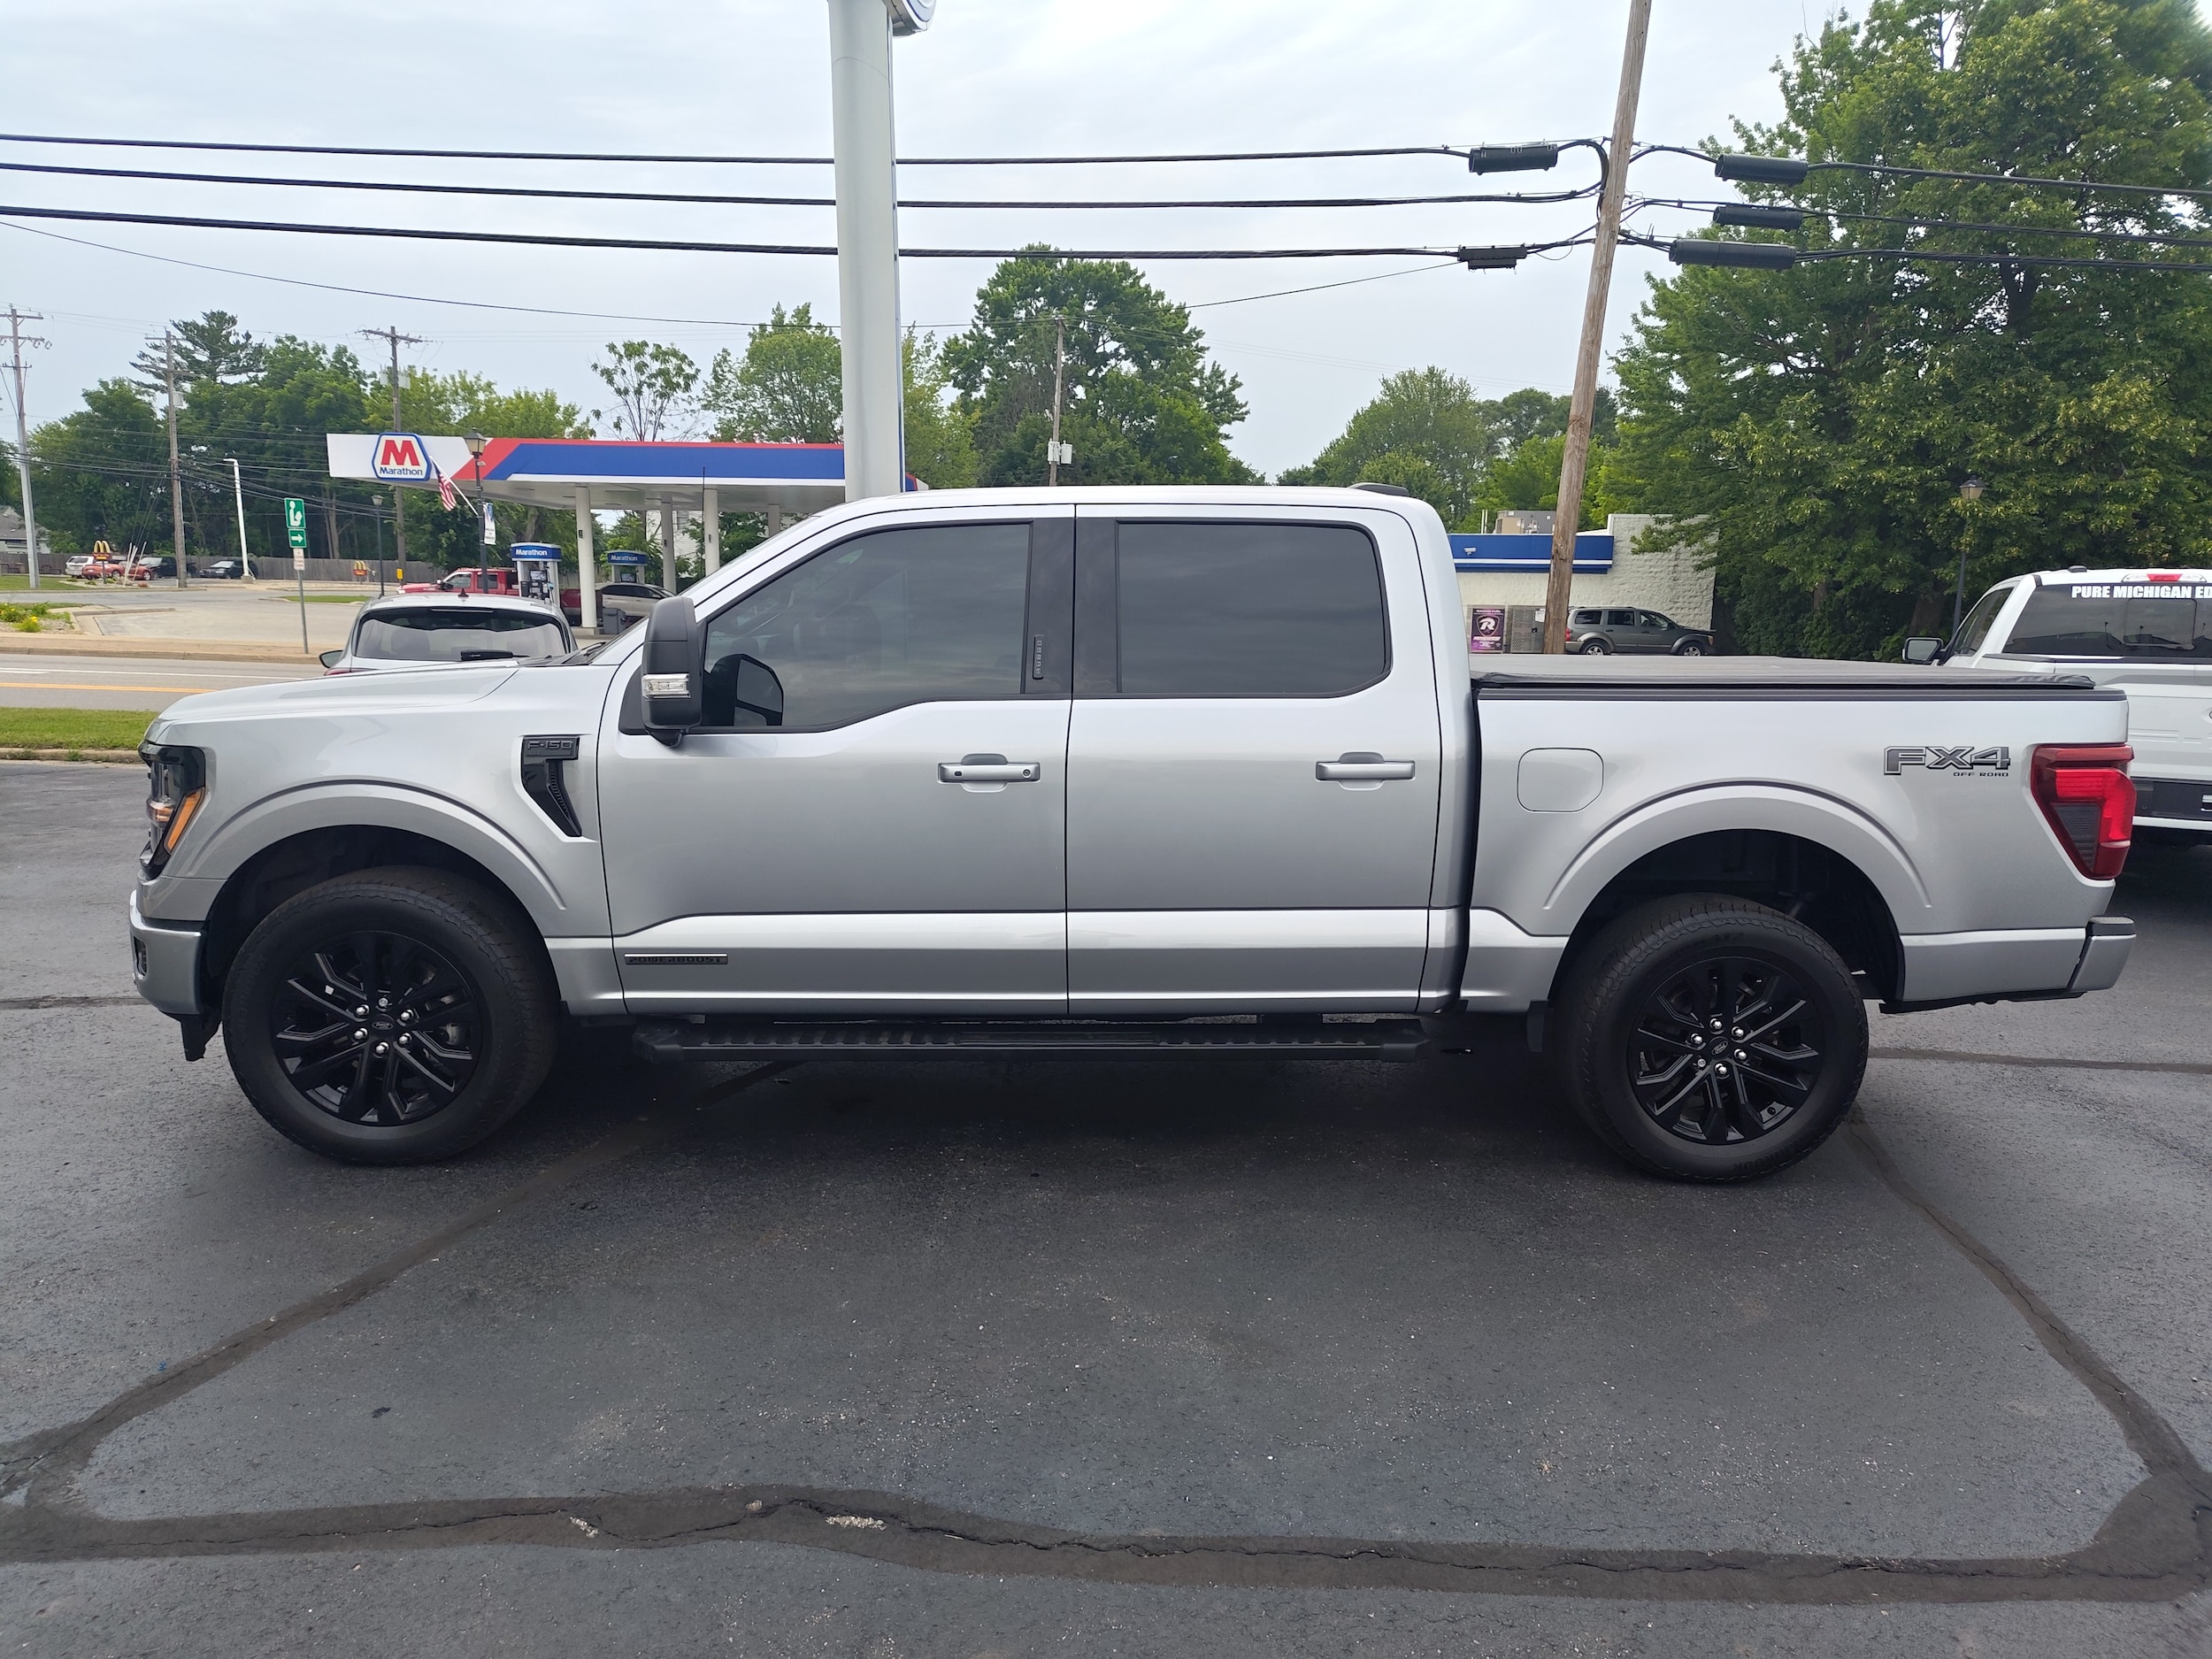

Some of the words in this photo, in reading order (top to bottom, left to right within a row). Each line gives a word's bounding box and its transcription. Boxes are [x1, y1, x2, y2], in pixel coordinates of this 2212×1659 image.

[380, 439, 420, 466] M
[380, 466, 423, 475] Marathon
[2071, 586, 2111, 598] PURE
[2113, 586, 2193, 599] MICHIGAN
[1479, 618, 1496, 631] R
[527, 740, 573, 749] F-150
[1884, 746, 2010, 776] FX4
